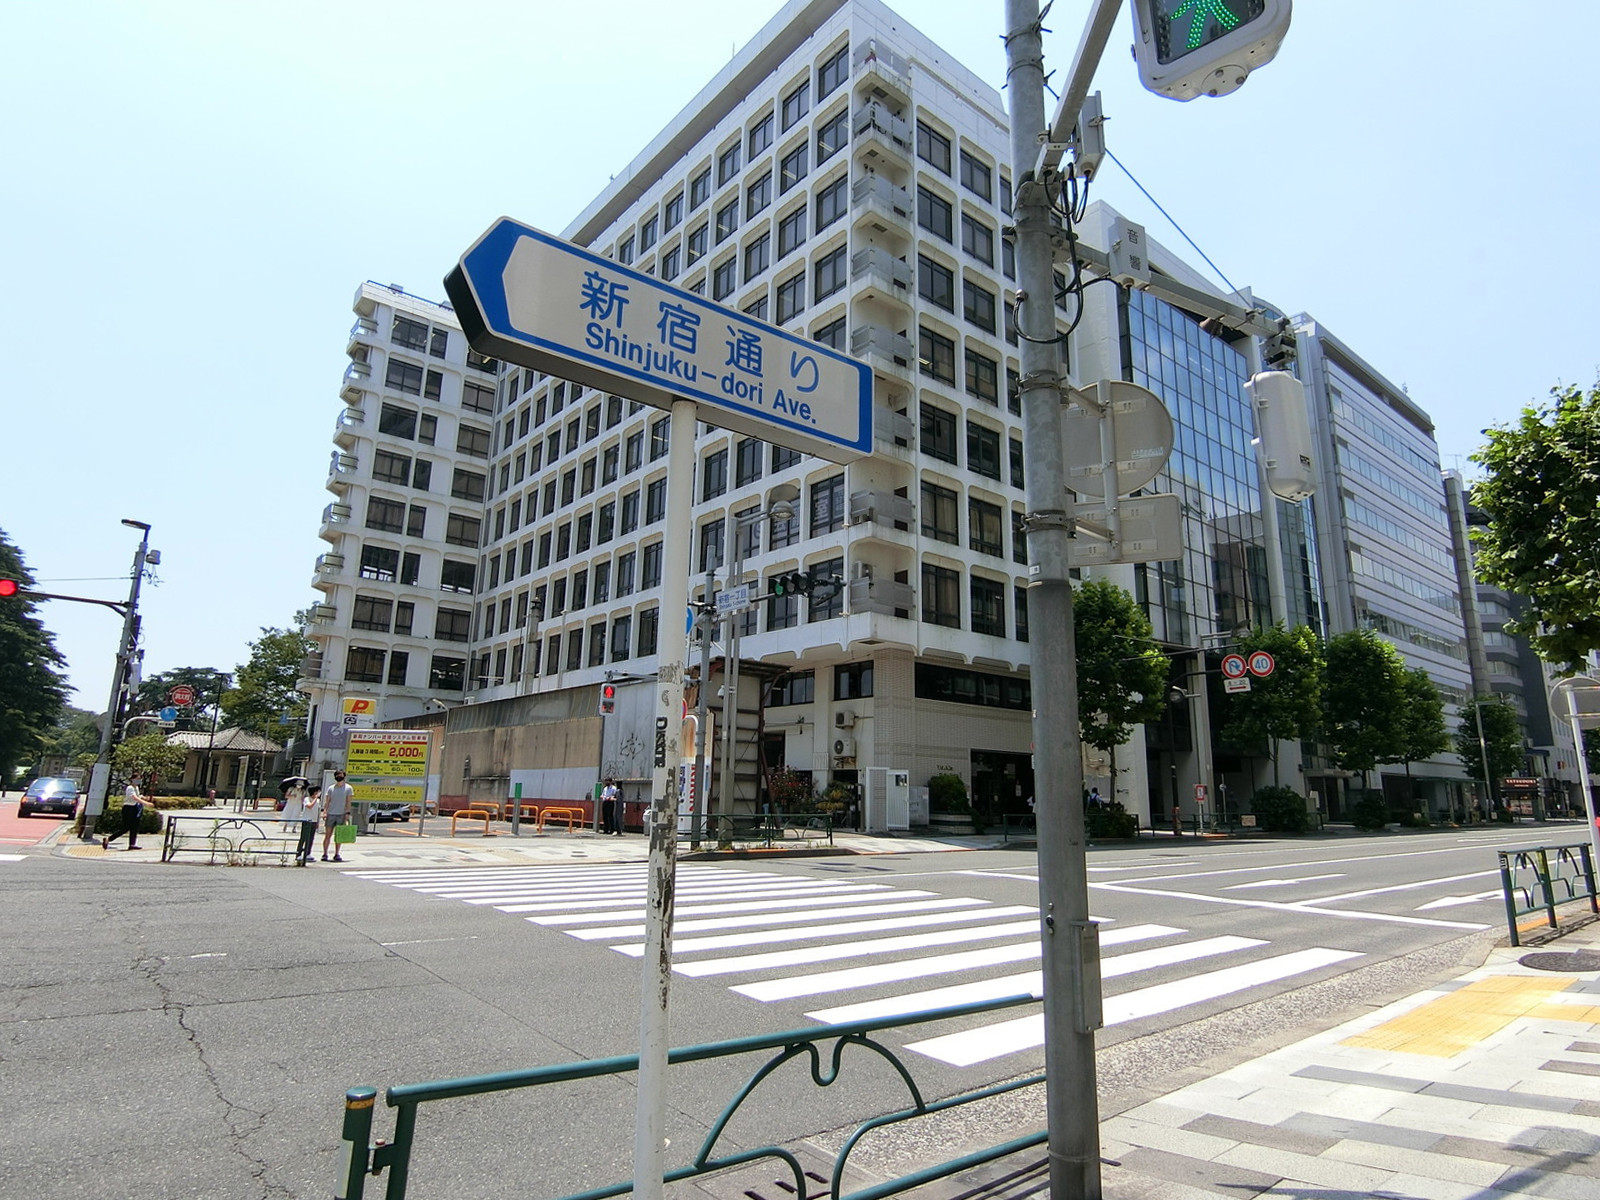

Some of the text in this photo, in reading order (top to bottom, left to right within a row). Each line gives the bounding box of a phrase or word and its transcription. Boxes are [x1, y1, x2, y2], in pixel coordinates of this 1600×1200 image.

[1126, 228, 1141, 271] 音響
[579, 270, 820, 393] 新宿通り
[772, 389, 817, 424] Ave.
[1254, 657, 1269, 670] 40
[351, 699, 369, 713] P
